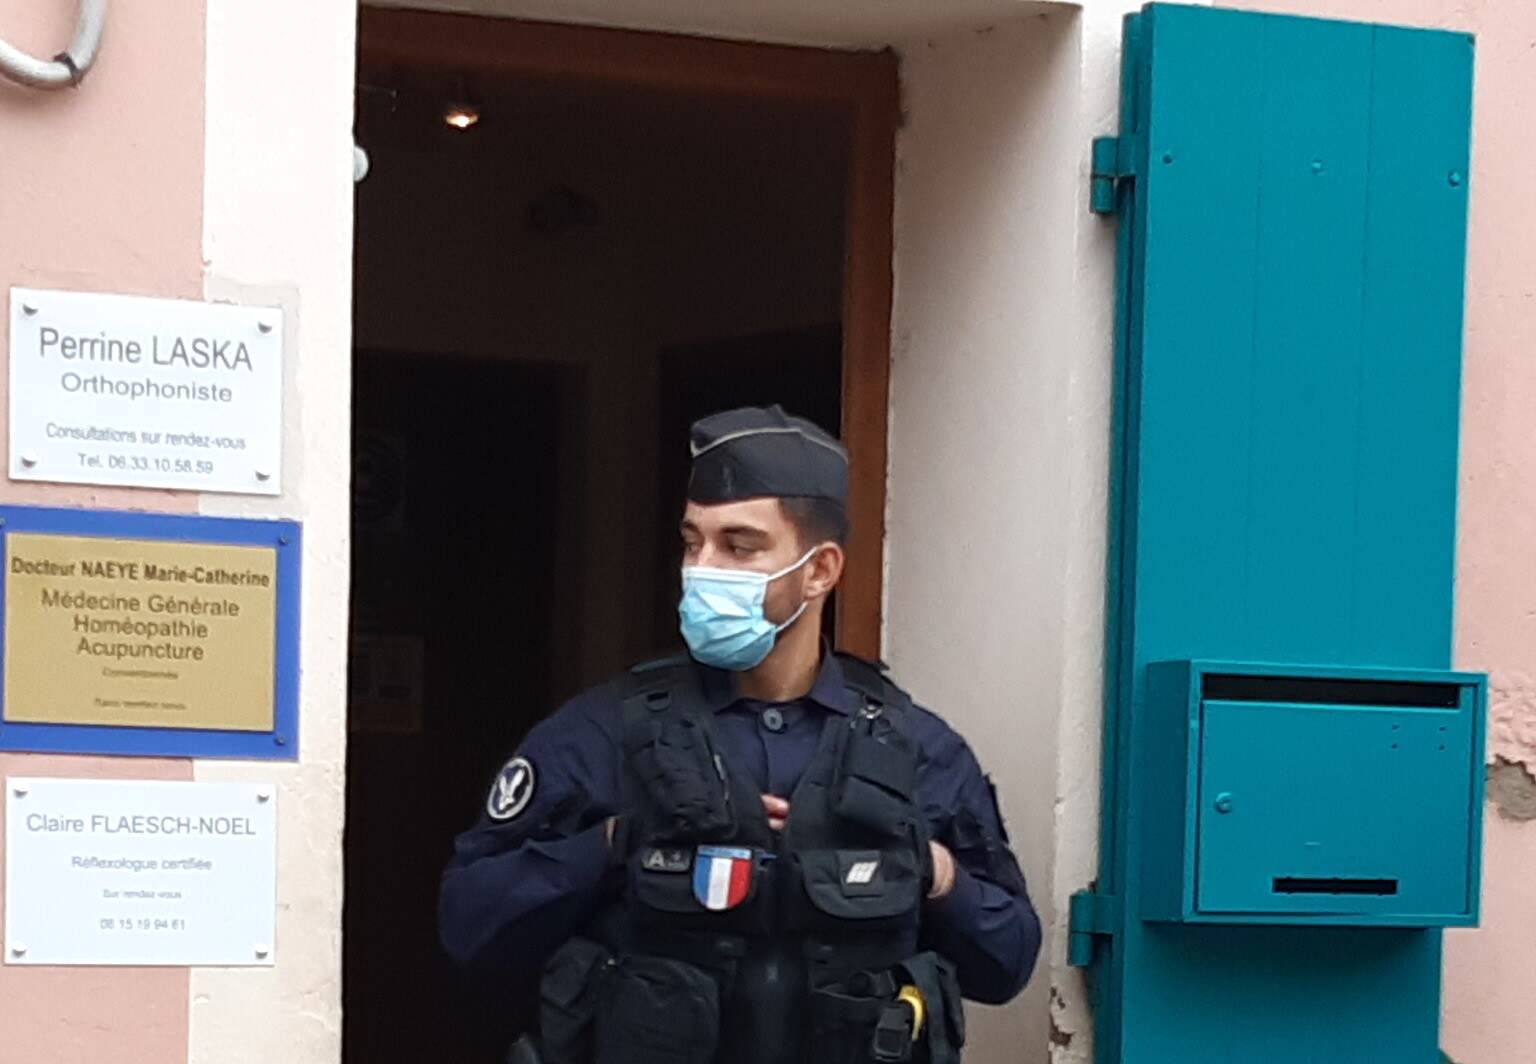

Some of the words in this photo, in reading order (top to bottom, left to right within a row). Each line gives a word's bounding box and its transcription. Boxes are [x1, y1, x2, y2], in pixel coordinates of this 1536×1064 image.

[39, 327, 141, 363] Perrine
[153, 335, 253, 372] LASKA
[61, 371, 232, 402] Orthophoniste
[46, 422, 137, 443] Consultations
[141, 433, 161, 445] sur
[165, 432, 246, 450] rendez-vous
[11, 556, 76, 577] Docteur
[81, 560, 139, 581] NAEYE
[144, 563, 270, 587] Marie-Catherine
[41, 587, 140, 613] Médecine
[148, 593, 240, 617] Générale
[73, 614, 208, 640] Homéopathie
[76, 637, 205, 661] Acupuncture
[26, 812, 85, 834] Claire
[91, 814, 257, 836] FLAESCH-NOEL
